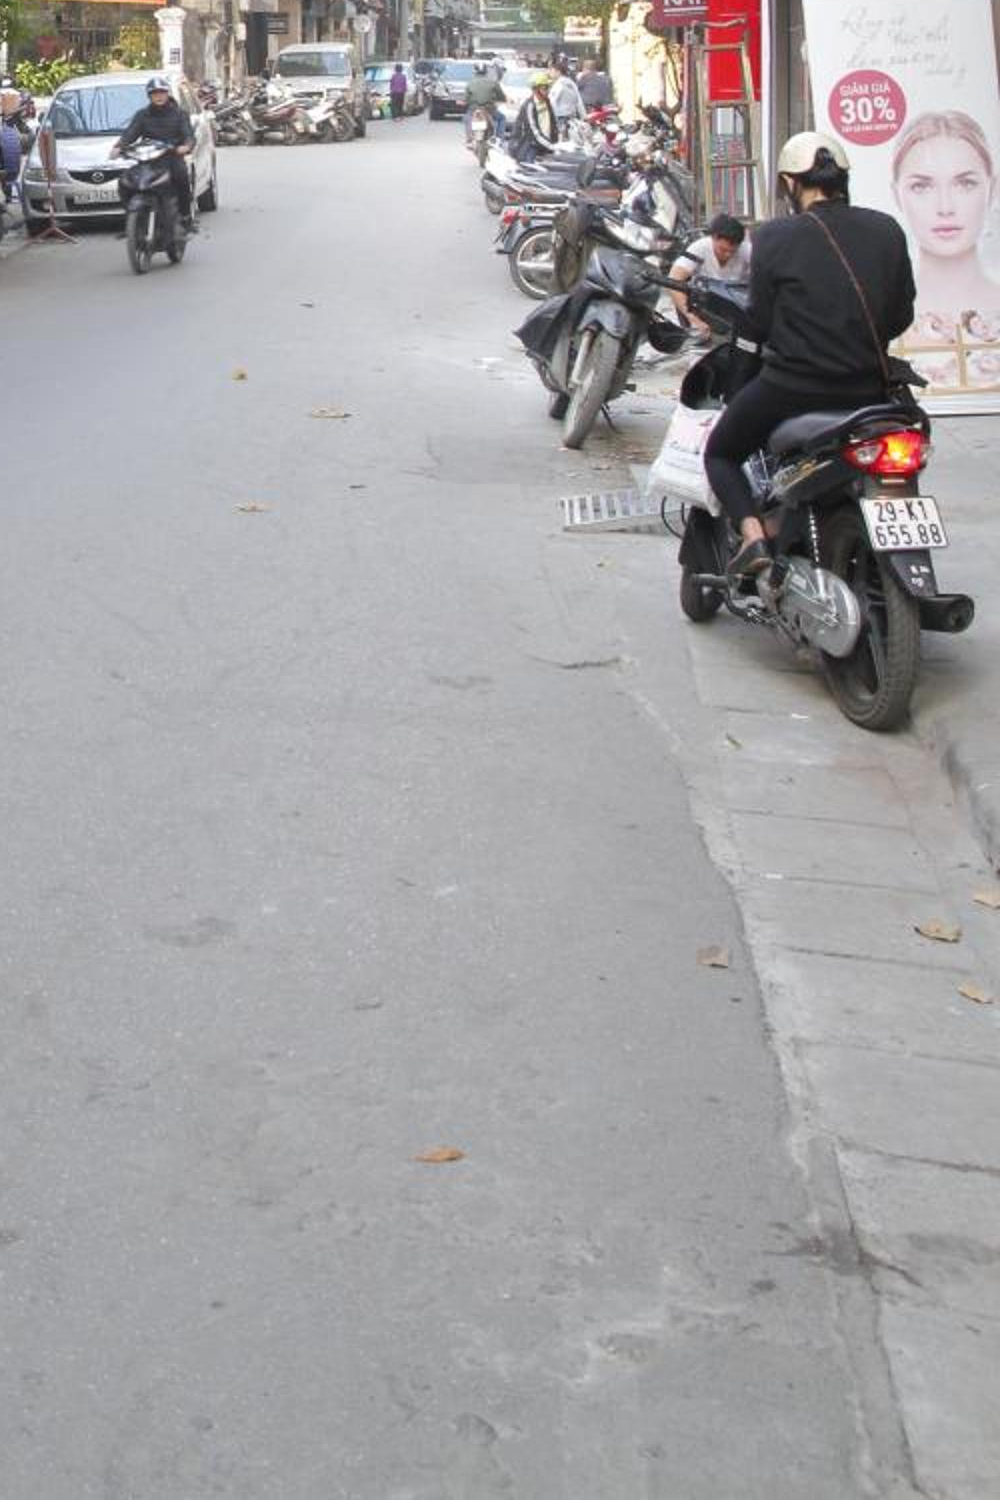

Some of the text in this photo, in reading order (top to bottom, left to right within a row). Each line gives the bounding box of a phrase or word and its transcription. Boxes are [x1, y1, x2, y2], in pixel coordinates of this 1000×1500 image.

[840, 95, 896, 124] 30%
[873, 499, 928, 522] 29-K1
[875, 523, 943, 546] 655.88
